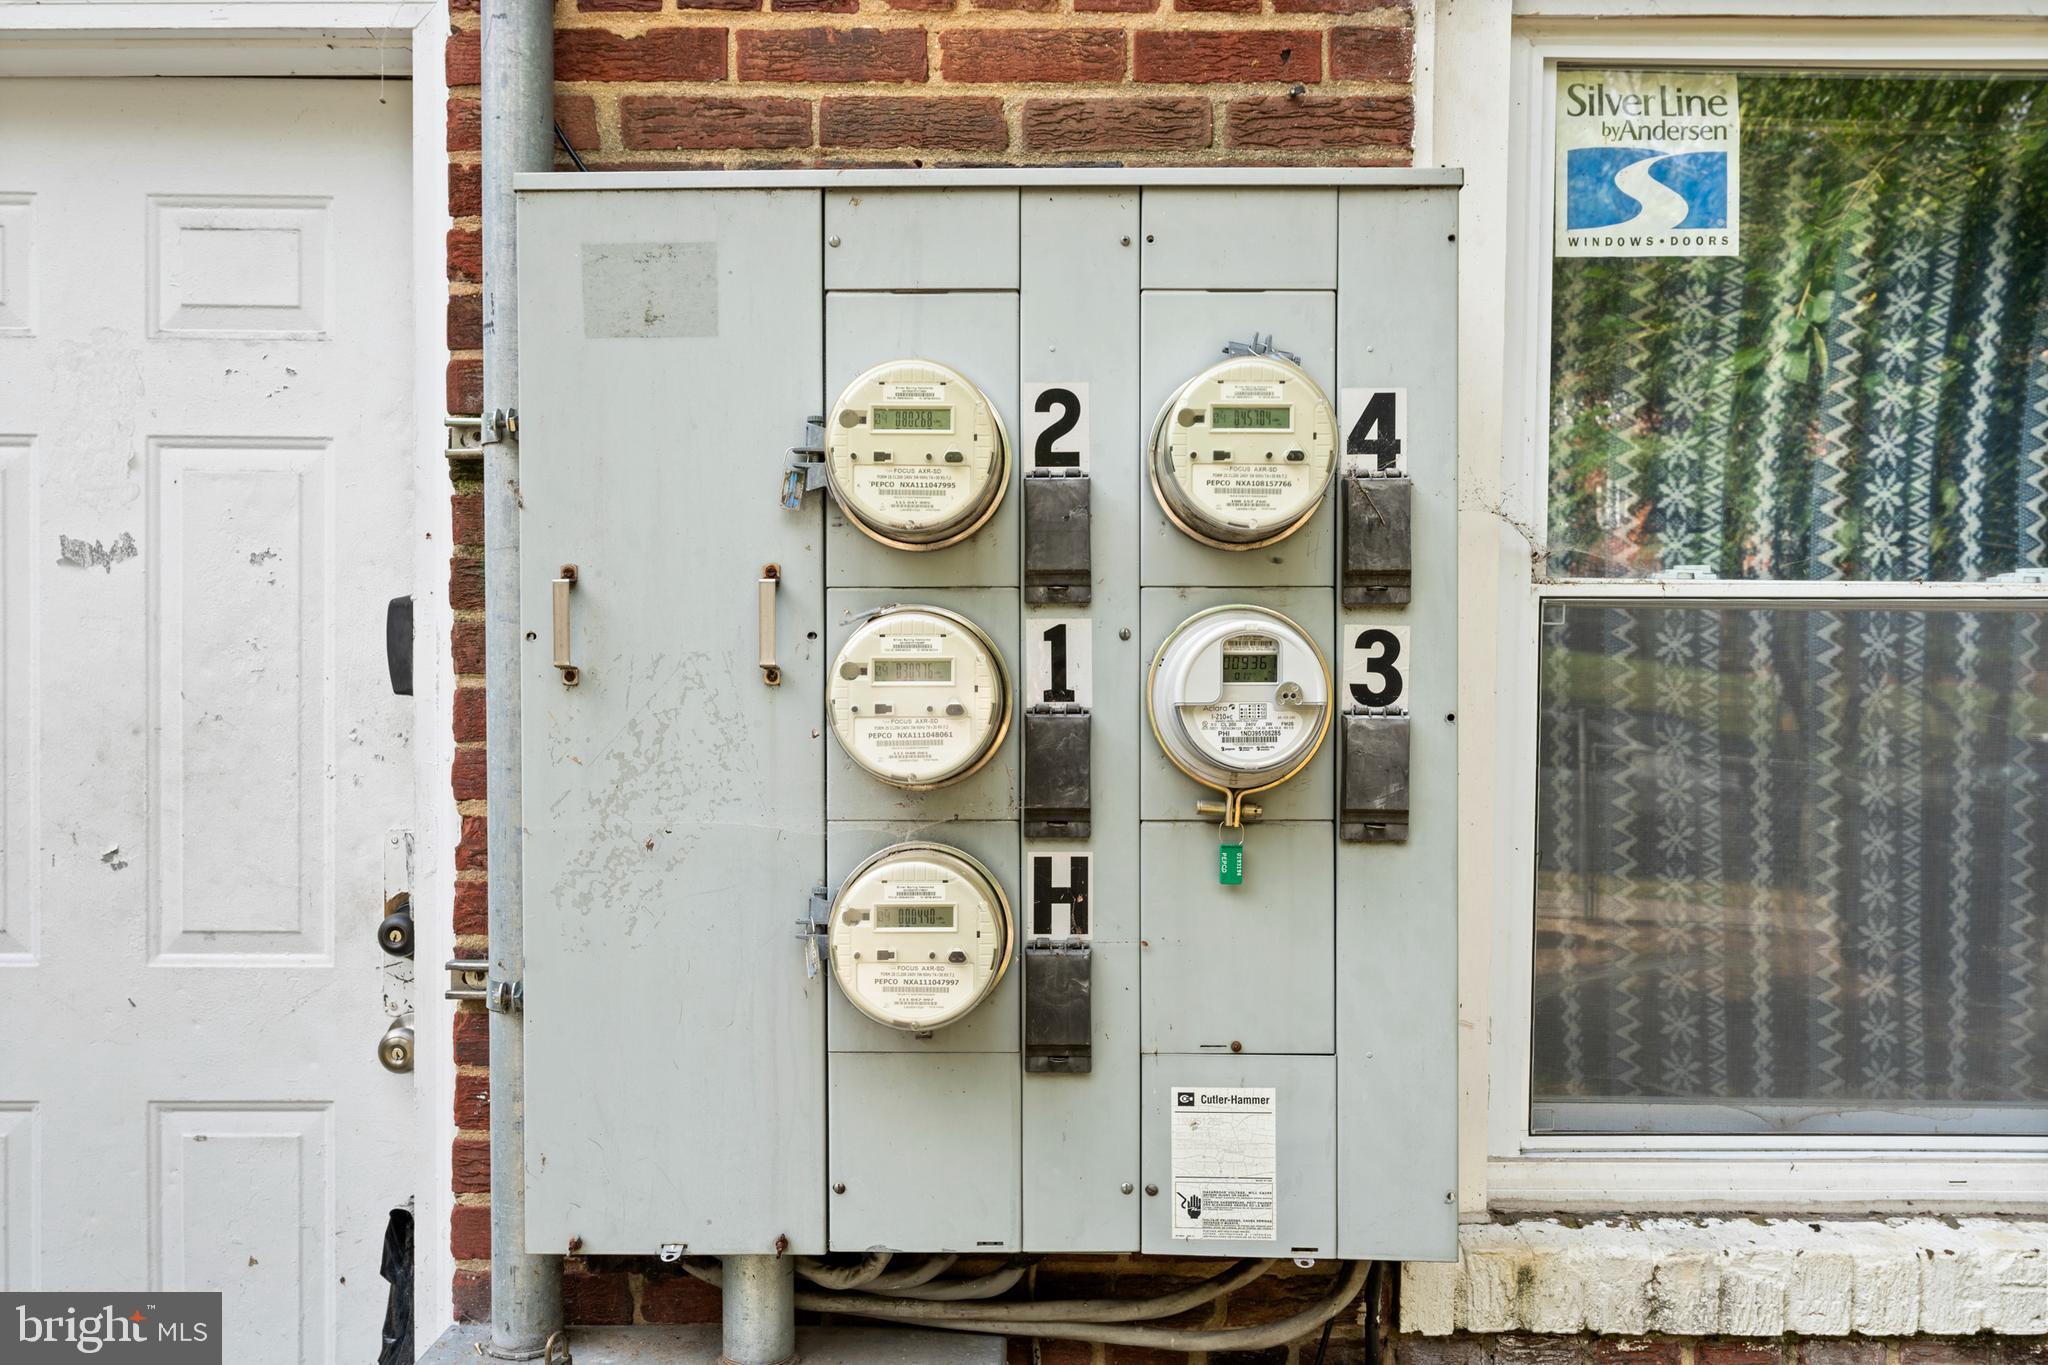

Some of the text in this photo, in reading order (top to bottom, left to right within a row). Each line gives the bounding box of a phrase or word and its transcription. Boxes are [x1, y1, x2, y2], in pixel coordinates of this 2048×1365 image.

[1618, 120, 1727, 141] Andersen
[1568, 236, 1729, 247] WINDOWS DOORS
[1035, 388, 1081, 467] 2
[1347, 392, 1401, 471] 4
[1044, 624, 1075, 702] 1
[1350, 629, 1403, 707] 3
[1034, 857, 1088, 934] H
[1200, 1094, 1271, 1105] Cutler-Hammer
